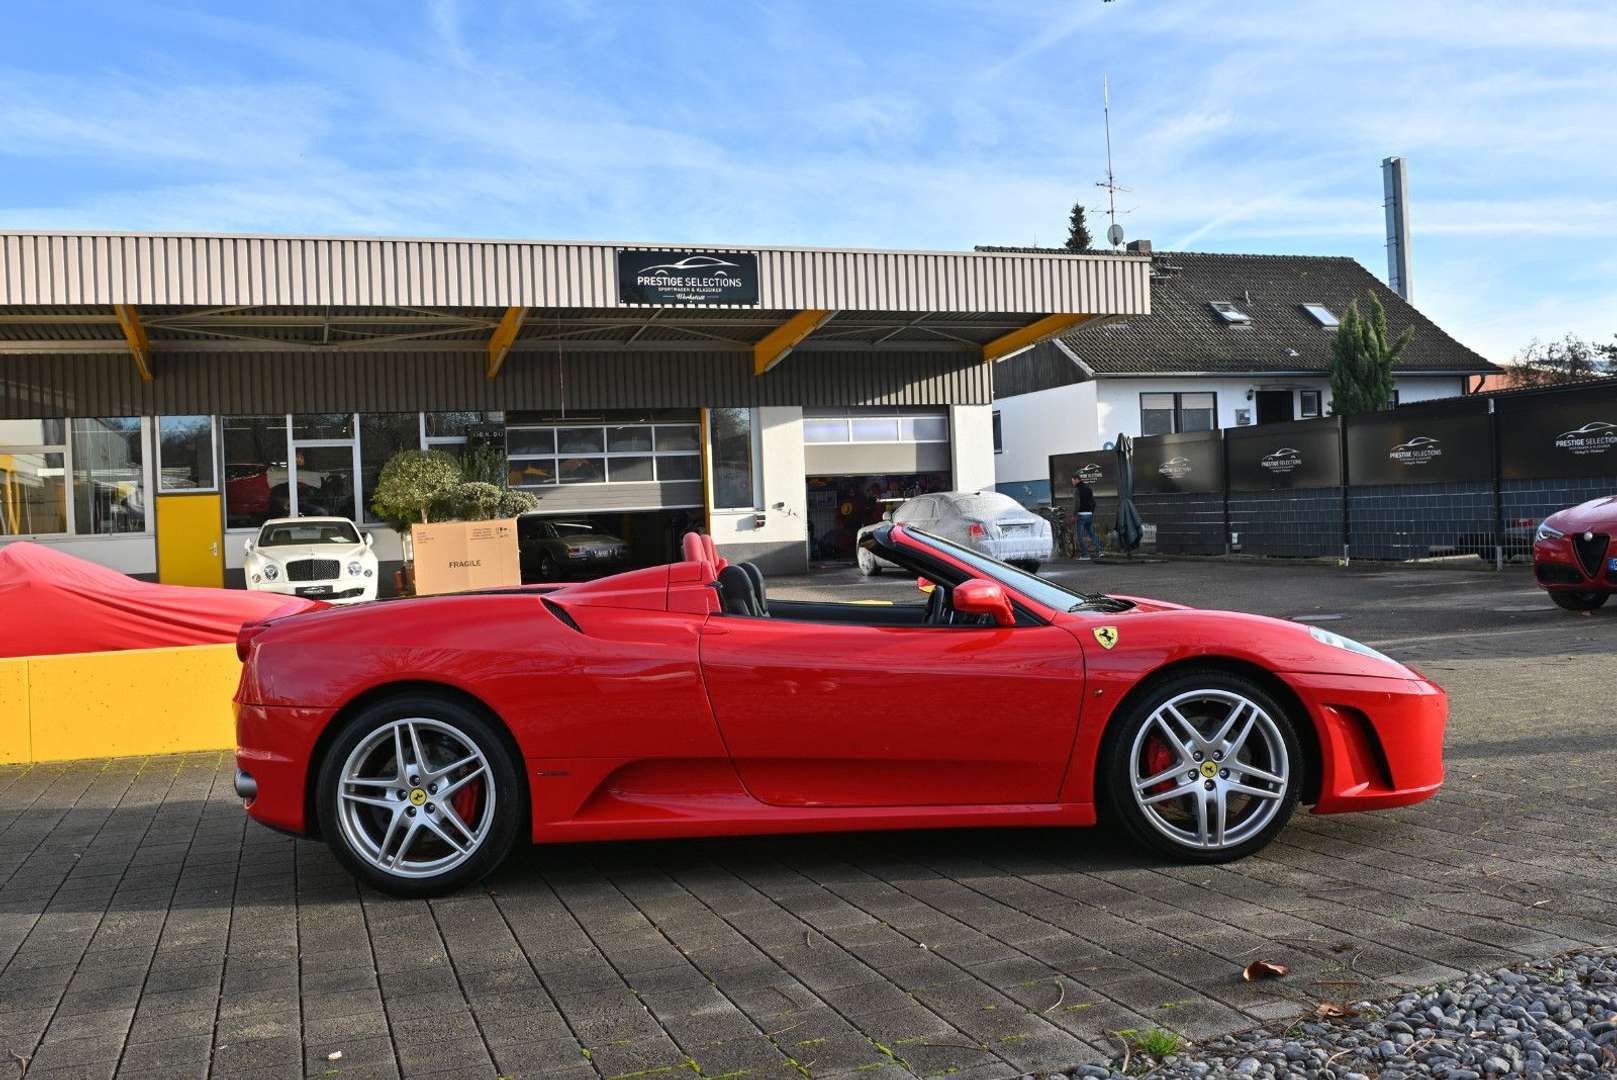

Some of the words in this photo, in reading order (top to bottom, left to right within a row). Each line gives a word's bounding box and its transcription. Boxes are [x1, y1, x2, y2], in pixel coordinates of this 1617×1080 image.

[637, 276, 683, 286] PRESTIGE
[685, 277, 742, 287] SELECTIONS
[1556, 439, 1585, 447] PRESTIGE
[1412, 449, 1442, 457] SELECTIONS
[449, 560, 481, 568] FRAGILE
